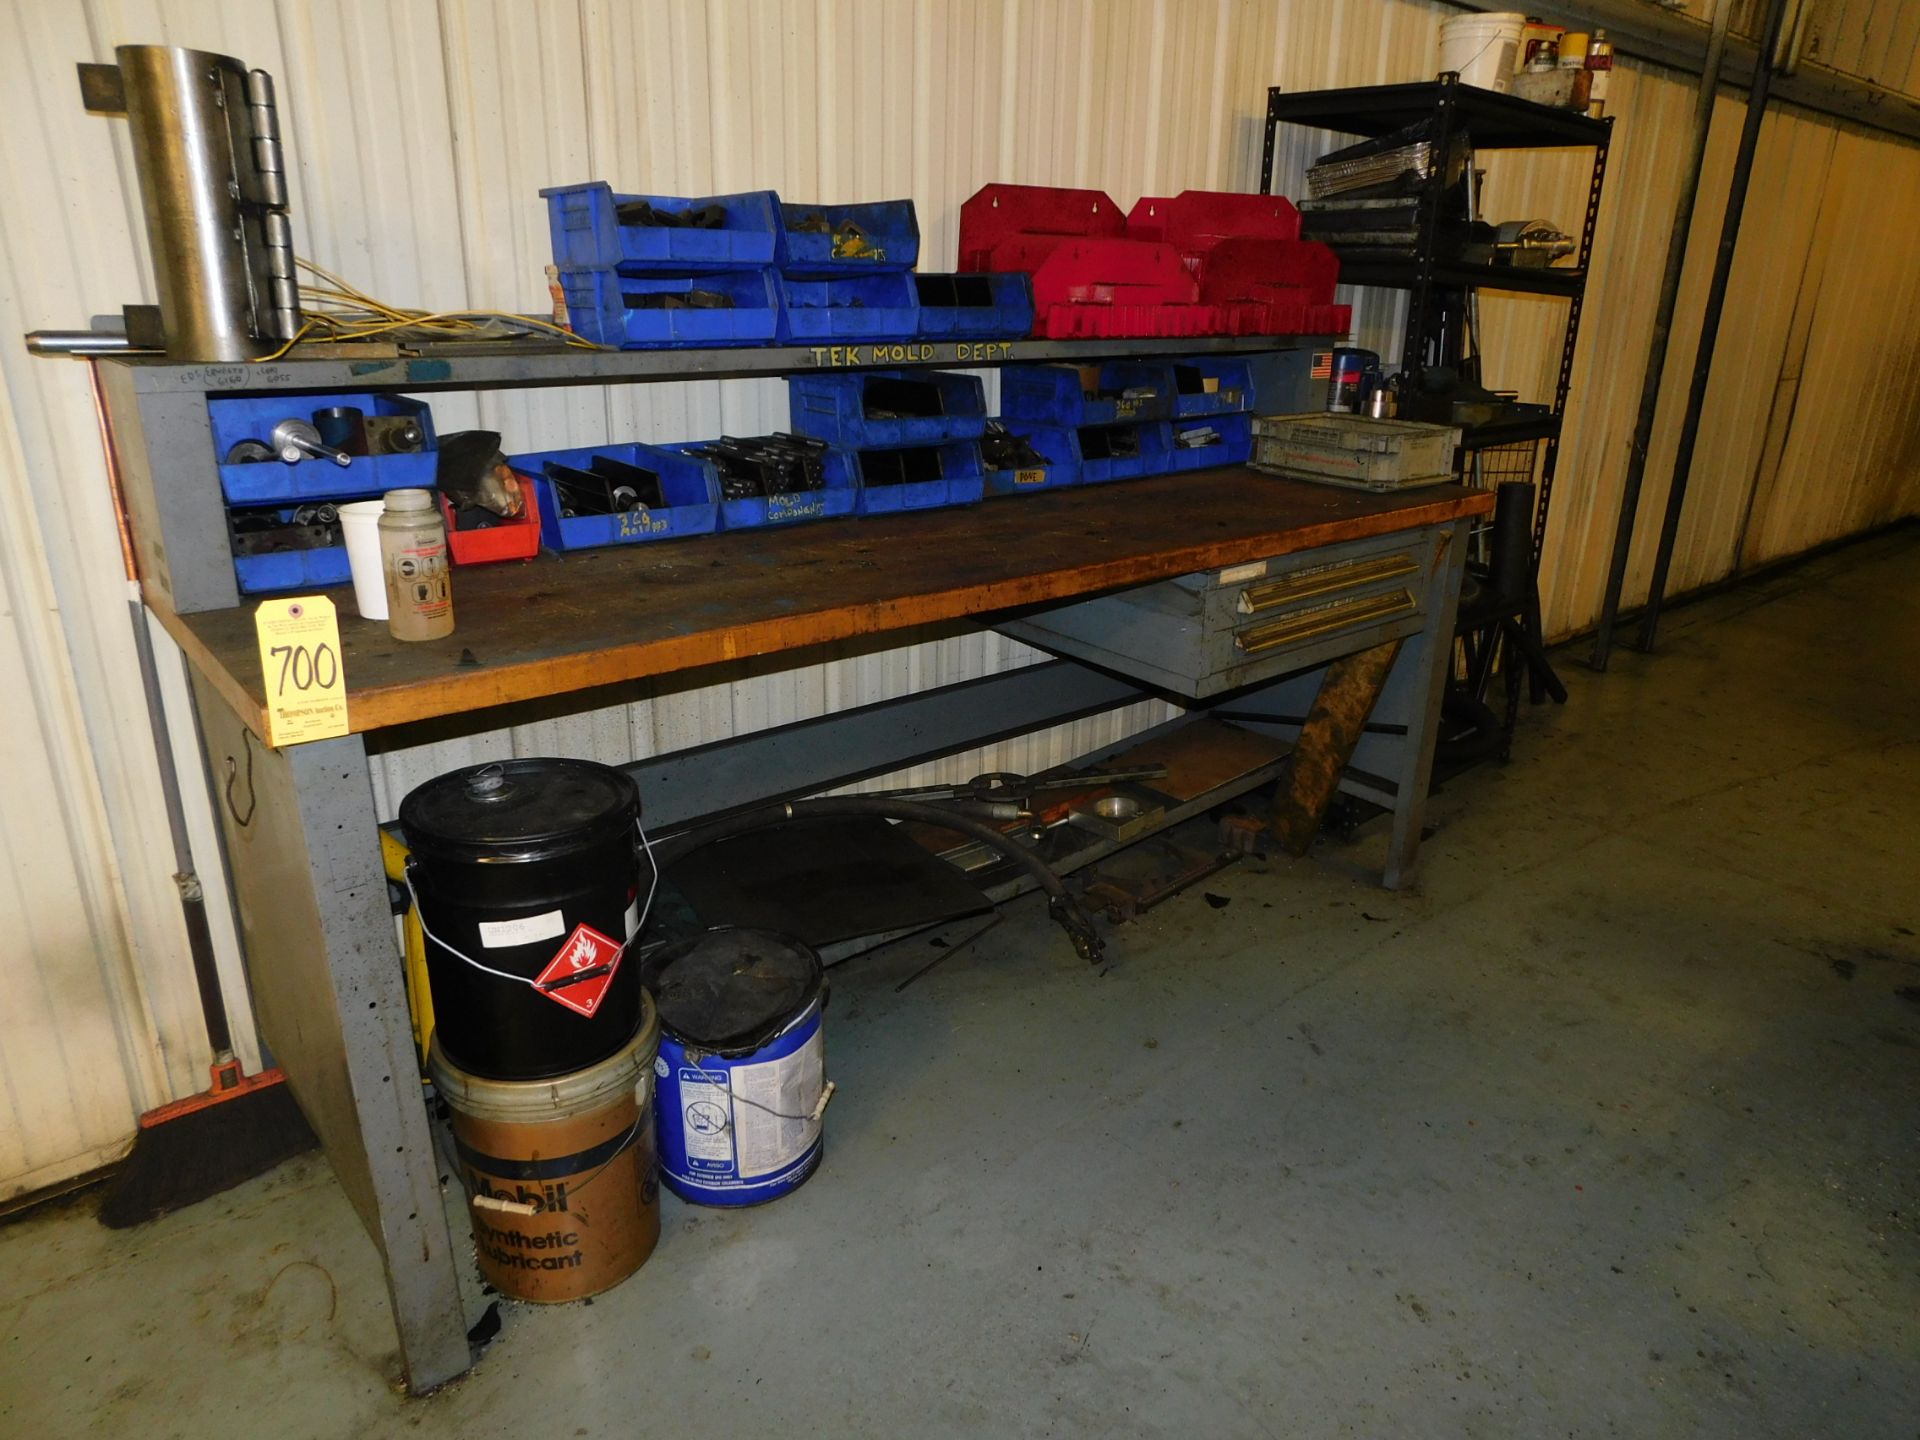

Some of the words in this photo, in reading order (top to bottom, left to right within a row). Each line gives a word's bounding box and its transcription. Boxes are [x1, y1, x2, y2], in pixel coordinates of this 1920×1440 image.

[811, 346, 860, 367] TEK
[872, 344, 935, 363] MOLD
[957, 342, 1015, 361] DEPT.
[270, 642, 337, 697] 700
[585, 998, 593, 1008] 3
